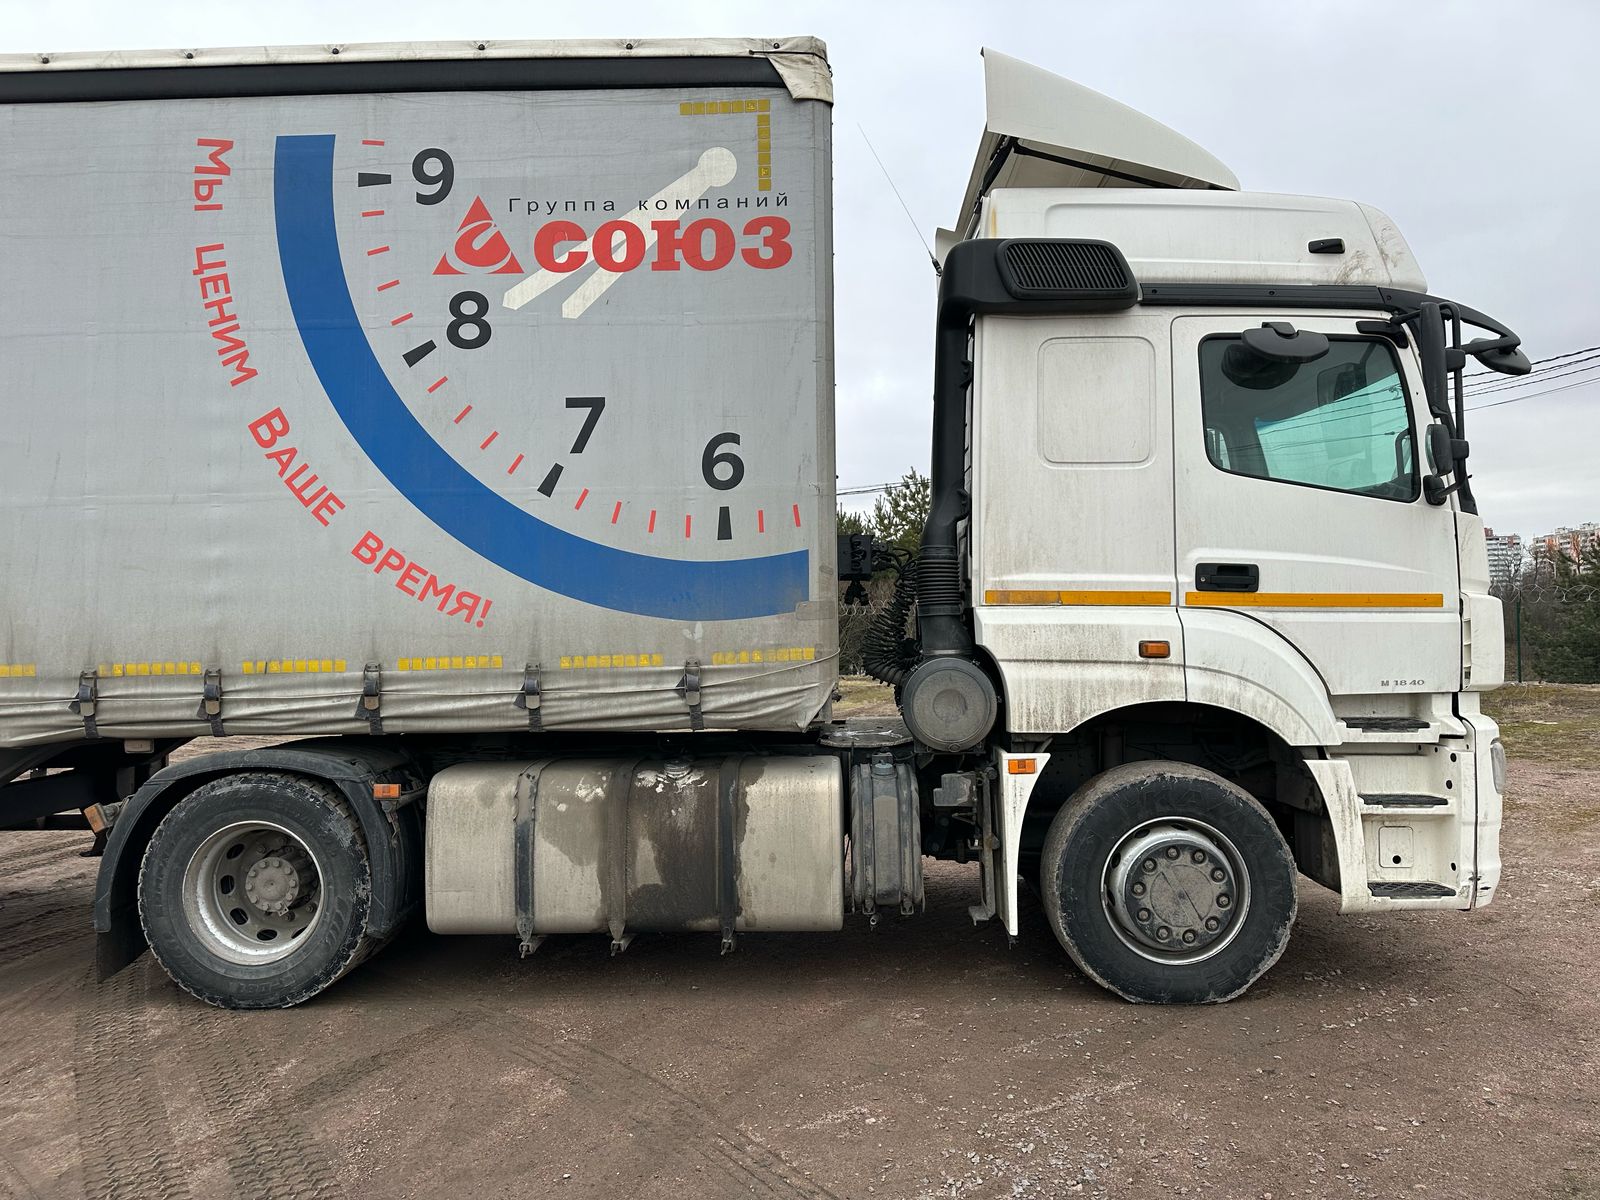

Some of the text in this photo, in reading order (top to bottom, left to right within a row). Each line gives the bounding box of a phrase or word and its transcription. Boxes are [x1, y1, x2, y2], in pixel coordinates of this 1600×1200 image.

[411, 147, 455, 206] 9
[509, 191, 789, 216] Группа компаний
[446, 290, 492, 350] 8
[192, 243, 258, 387] ЦЕНИМ
[351, 530, 493, 629] ВРЕМЯ!
[565, 396, 606, 454] 7
[701, 432, 745, 491] 6
